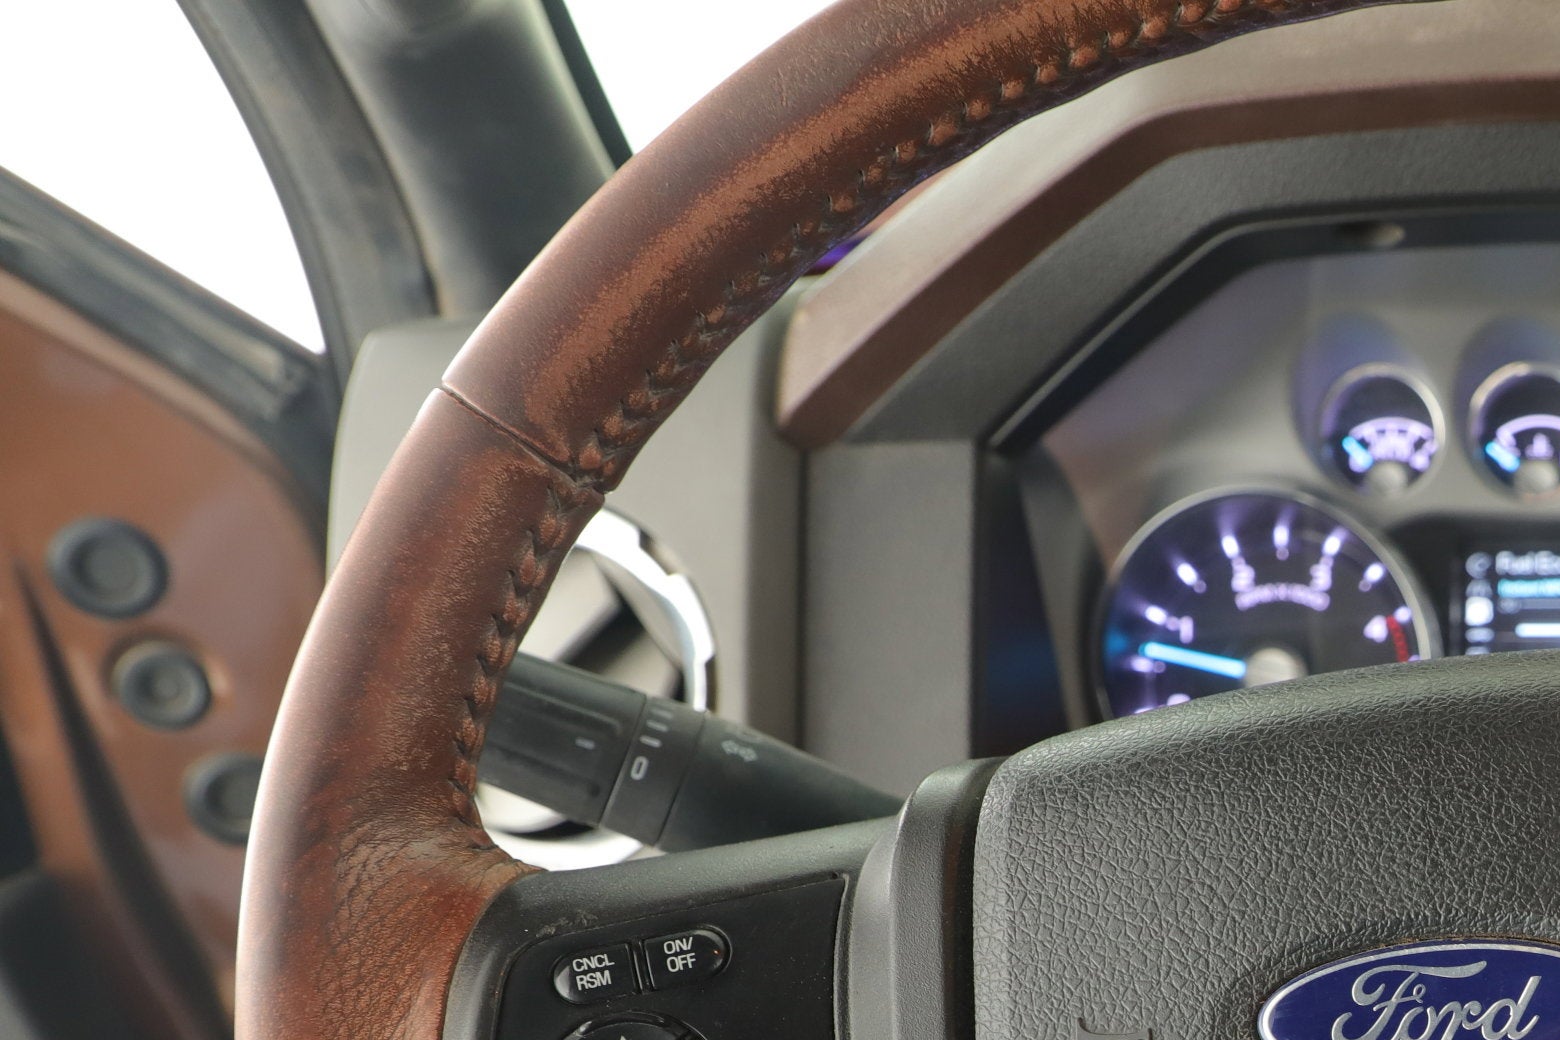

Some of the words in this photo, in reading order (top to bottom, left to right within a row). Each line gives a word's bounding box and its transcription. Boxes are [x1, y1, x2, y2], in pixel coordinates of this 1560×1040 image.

[663, 936, 693, 955] ON/
[572, 953, 615, 973] CNCL
[666, 952, 696, 973] OFF
[576, 971, 612, 991] RSM
